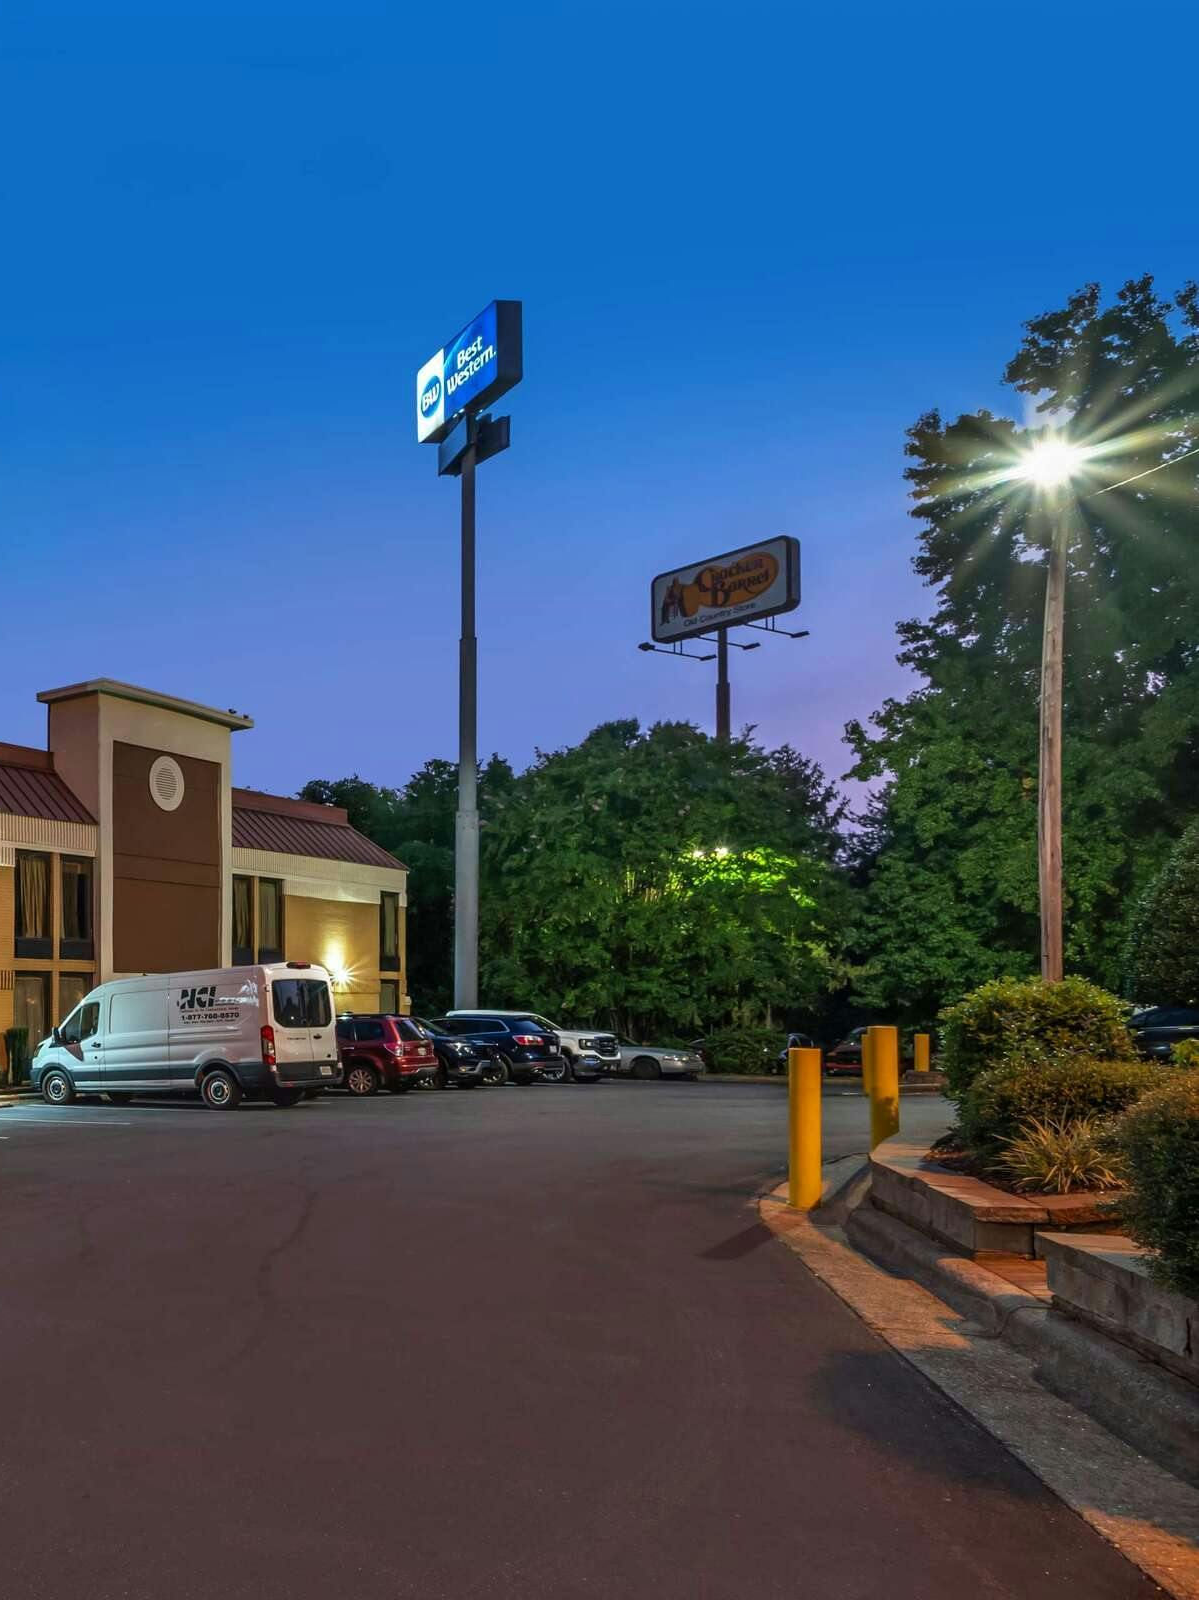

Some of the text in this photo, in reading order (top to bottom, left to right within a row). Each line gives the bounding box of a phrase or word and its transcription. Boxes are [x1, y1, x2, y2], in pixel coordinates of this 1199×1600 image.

[457, 336, 482, 369] Best
[422, 383, 439, 410] BW
[180, 986, 216, 1009] NCI
